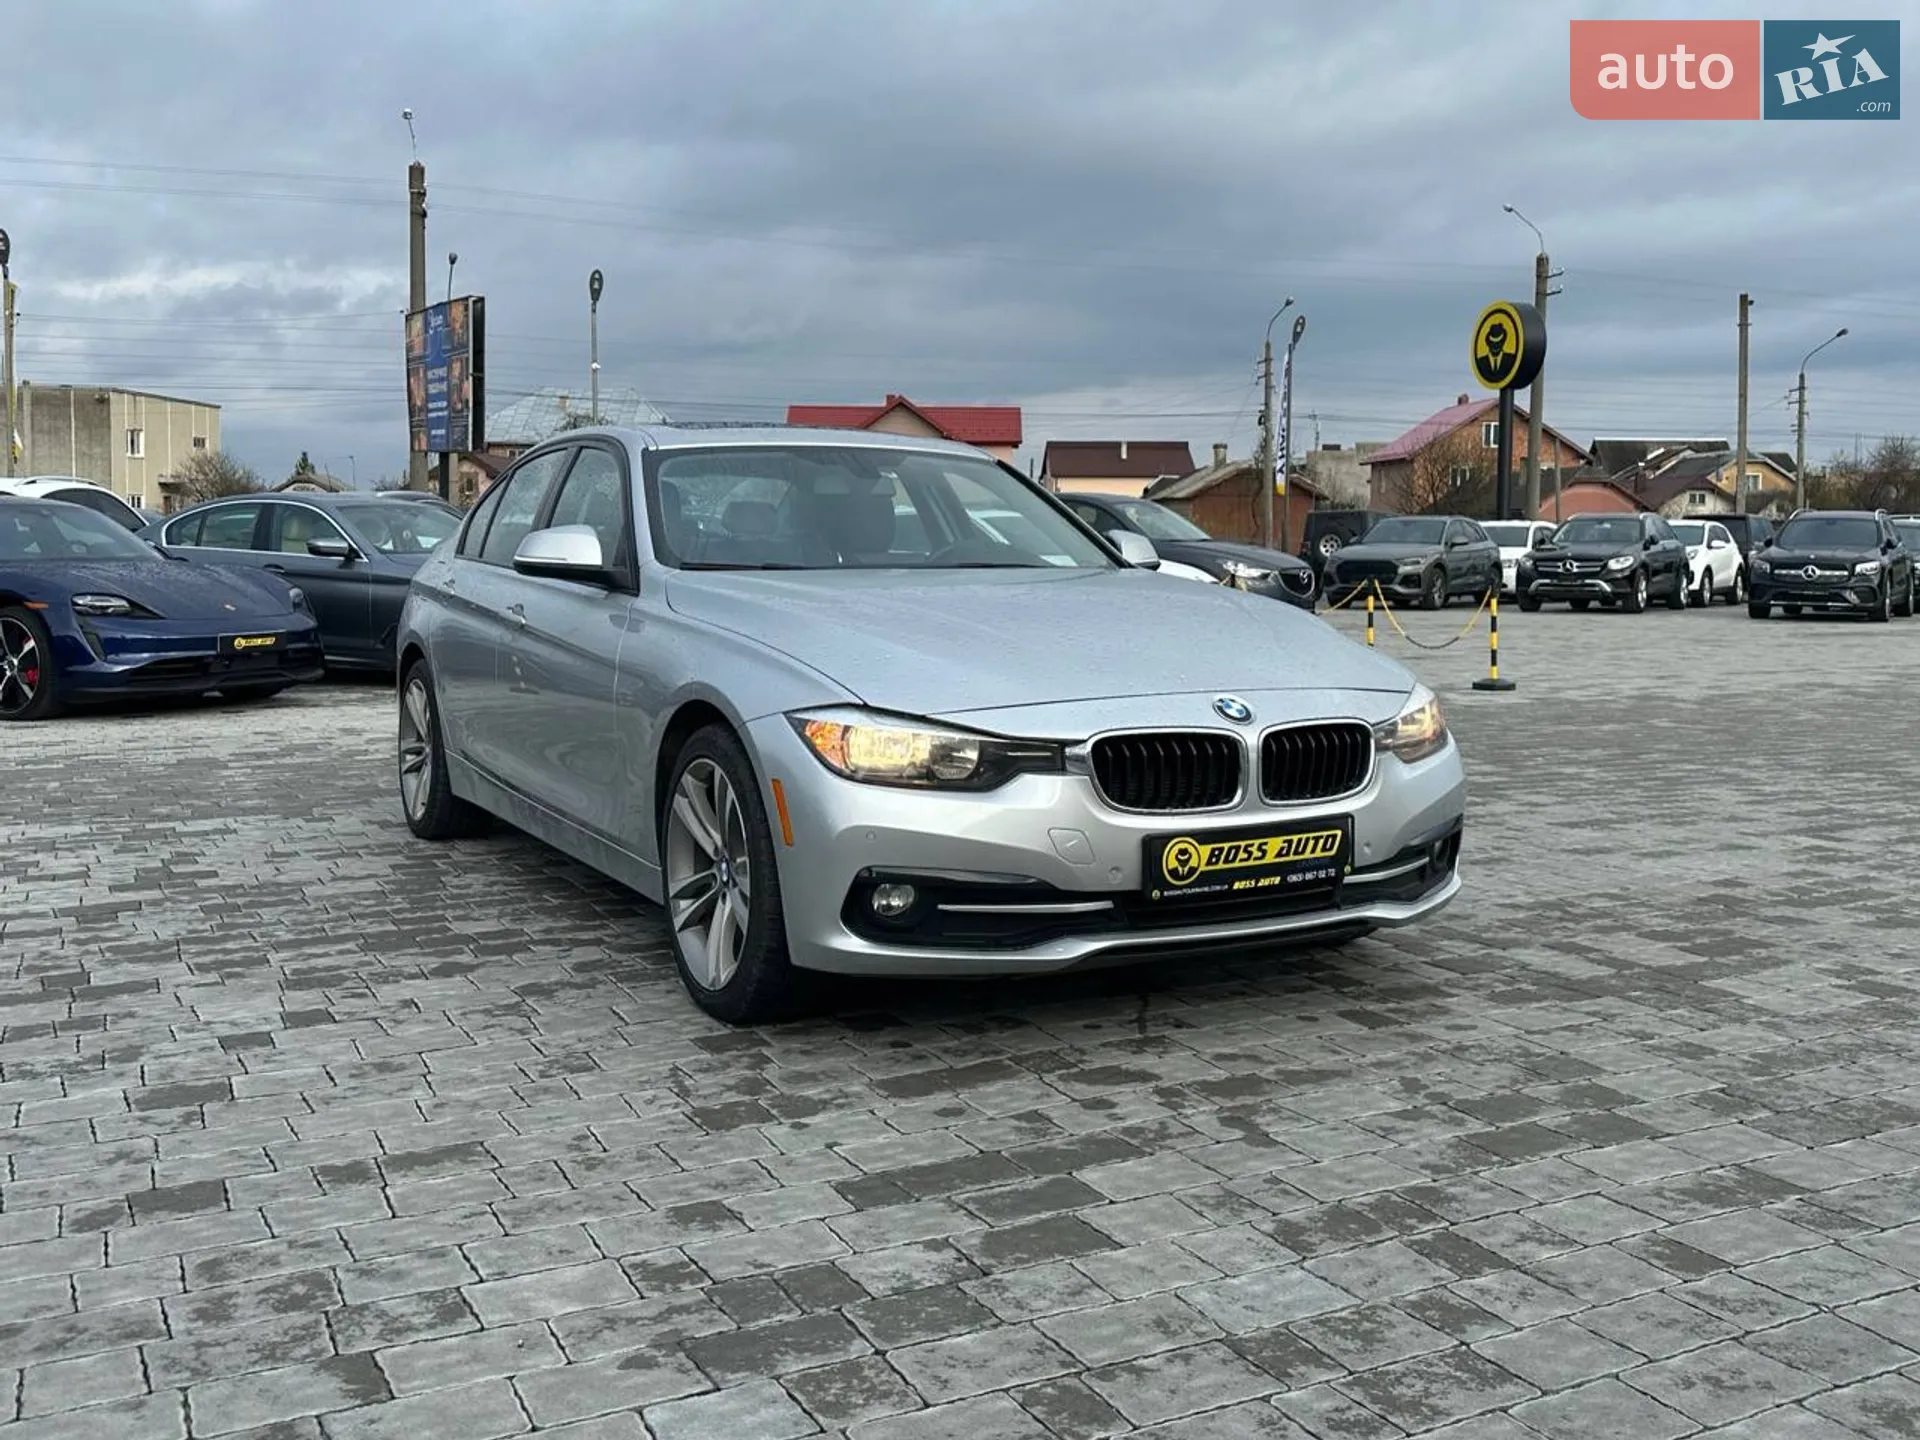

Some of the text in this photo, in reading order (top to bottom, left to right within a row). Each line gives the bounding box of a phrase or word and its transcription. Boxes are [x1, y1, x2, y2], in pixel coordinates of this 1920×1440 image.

[1205, 833, 1338, 867] BOSS AUTO
[1232, 876, 1281, 890] BOSS AUTO
